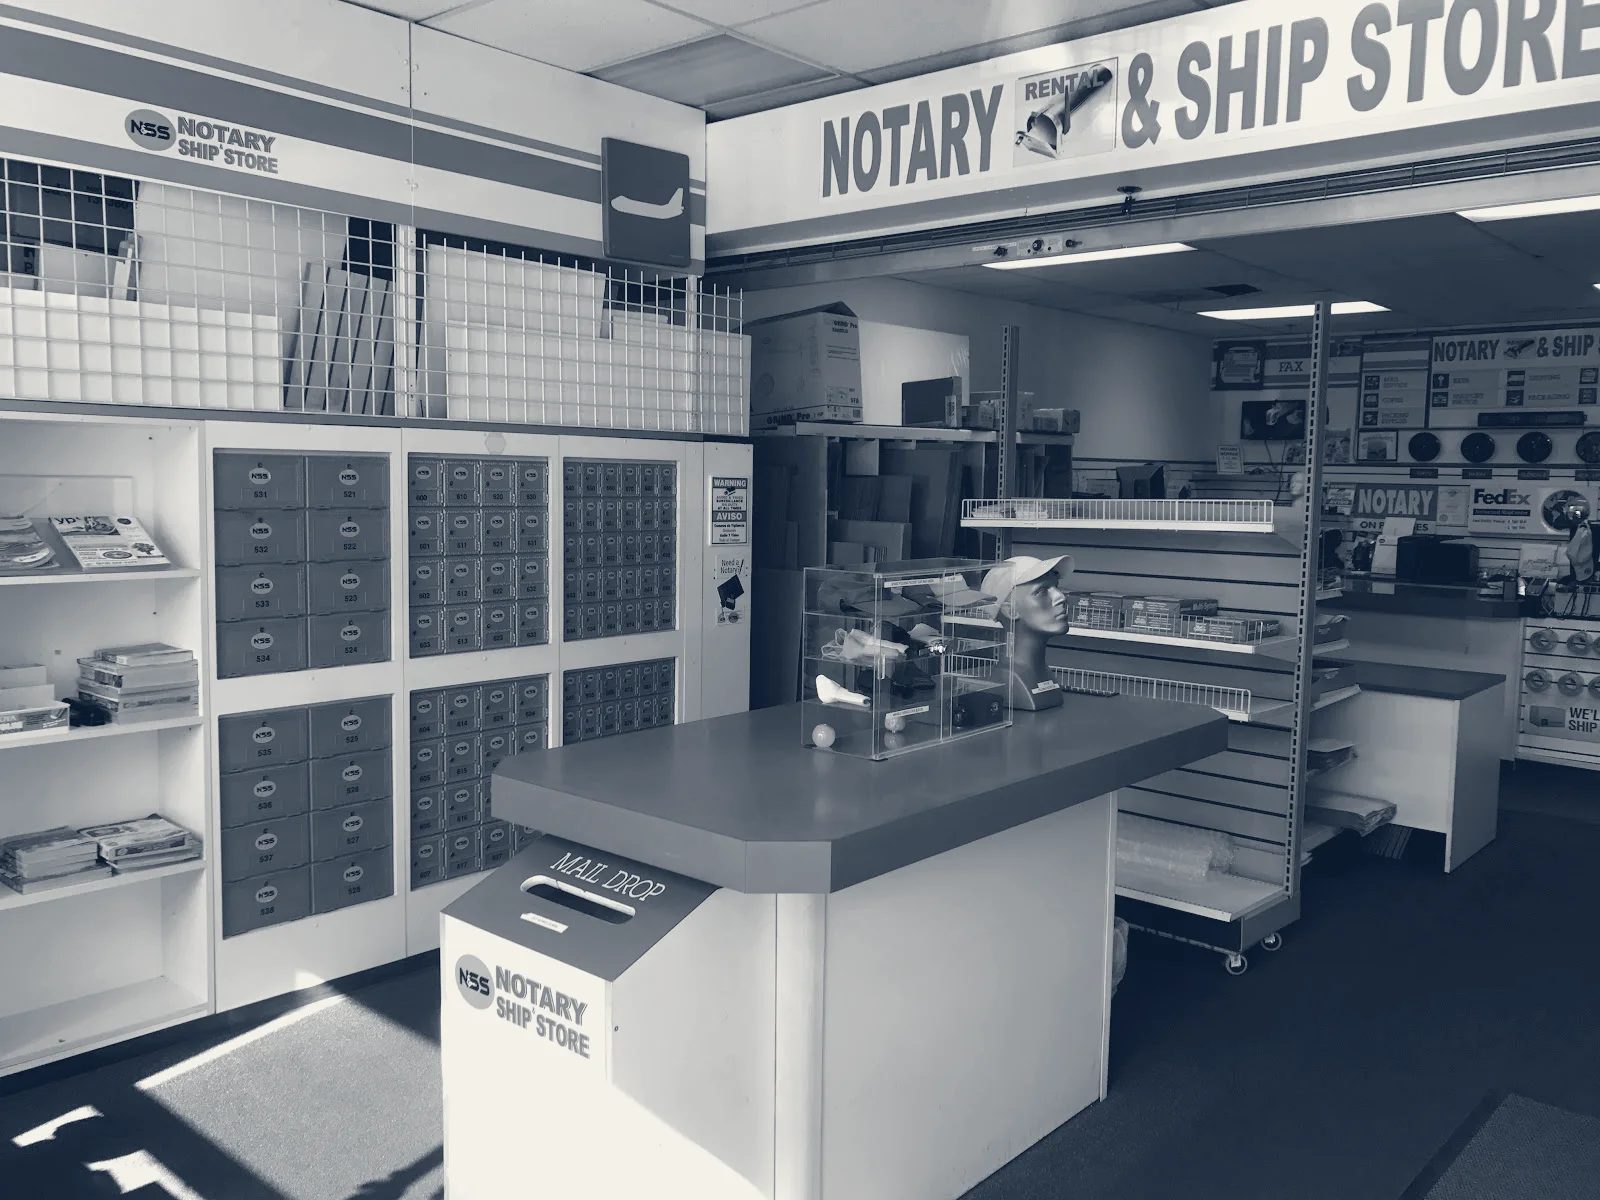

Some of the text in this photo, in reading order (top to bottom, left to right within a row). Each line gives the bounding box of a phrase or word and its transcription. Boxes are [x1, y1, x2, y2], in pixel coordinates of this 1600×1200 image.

[823, 0, 1600, 198] NOTARY RENTAL & SHIP STORE
[177, 115, 276, 153] NOTARY
[178, 138, 220, 161] SHIP
[223, 148, 279, 174] STORE
[1434, 334, 1595, 362] NOTARY & SHIP
[1278, 361, 1304, 373] FAX
[713, 479, 747, 488] WARNING
[253, 490, 267, 498] 531
[1473, 488, 1532, 505] FedEx
[1358, 488, 1433, 516] NOTARY
[716, 512, 743, 521] AVISO
[1360, 521, 1374, 529] ON
[252, 527, 269, 535] NSS
[254, 545, 269, 554] 532
[721, 558, 735, 567] Need
[253, 582, 270, 590] NSS
[344, 594, 358, 602] 523
[255, 600, 269, 608] 533
[343, 629, 358, 637] NSS
[253, 637, 271, 645] NSS
[345, 646, 358, 654] 524
[256, 655, 270, 663] 534
[1568, 720, 1598, 733] SHIP
[255, 731, 272, 739] NSS
[345, 736, 359, 744] 525
[257, 748, 272, 757] 535
[256, 785, 273, 793] NSS
[346, 786, 359, 794] 526
[258, 801, 272, 810] 536
[346, 836, 360, 844] 527
[259, 854, 273, 863] 537
[345, 869, 361, 878] NSS
[549, 851, 666, 902] MAIL DROP
[258, 890, 275, 899] NSS
[260, 907, 274, 915] 538
[495, 964, 588, 1027] NOTARY
[496, 995, 532, 1030] SHIP
[536, 1013, 591, 1060] STORE
